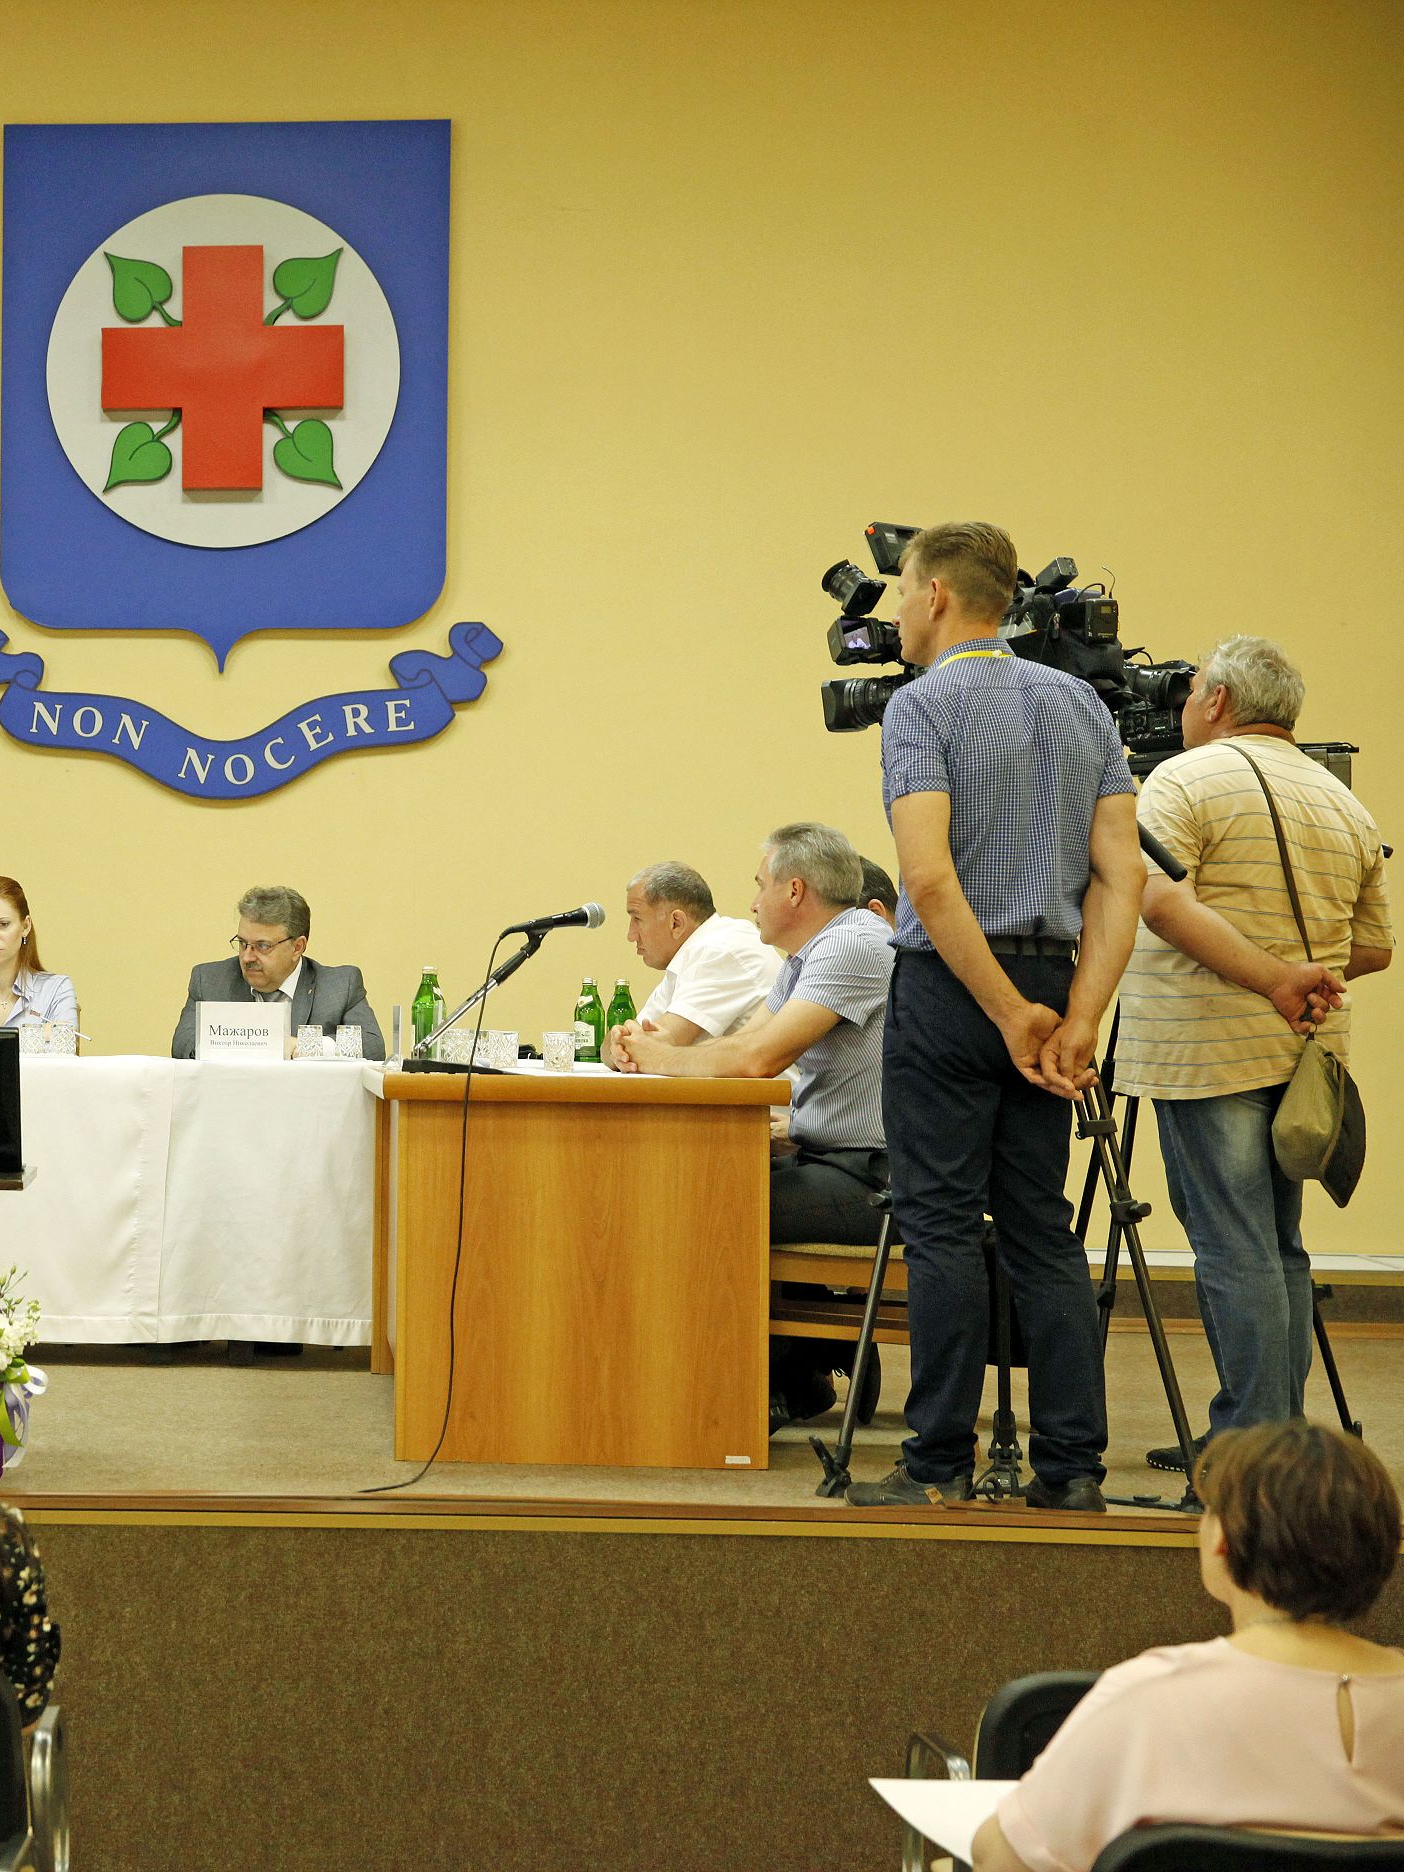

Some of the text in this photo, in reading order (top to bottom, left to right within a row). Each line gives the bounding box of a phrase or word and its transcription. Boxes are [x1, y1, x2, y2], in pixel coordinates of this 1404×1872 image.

[29, 699, 416, 786] NON NOCERE
[208, 1024, 269, 1040] Мажаров
